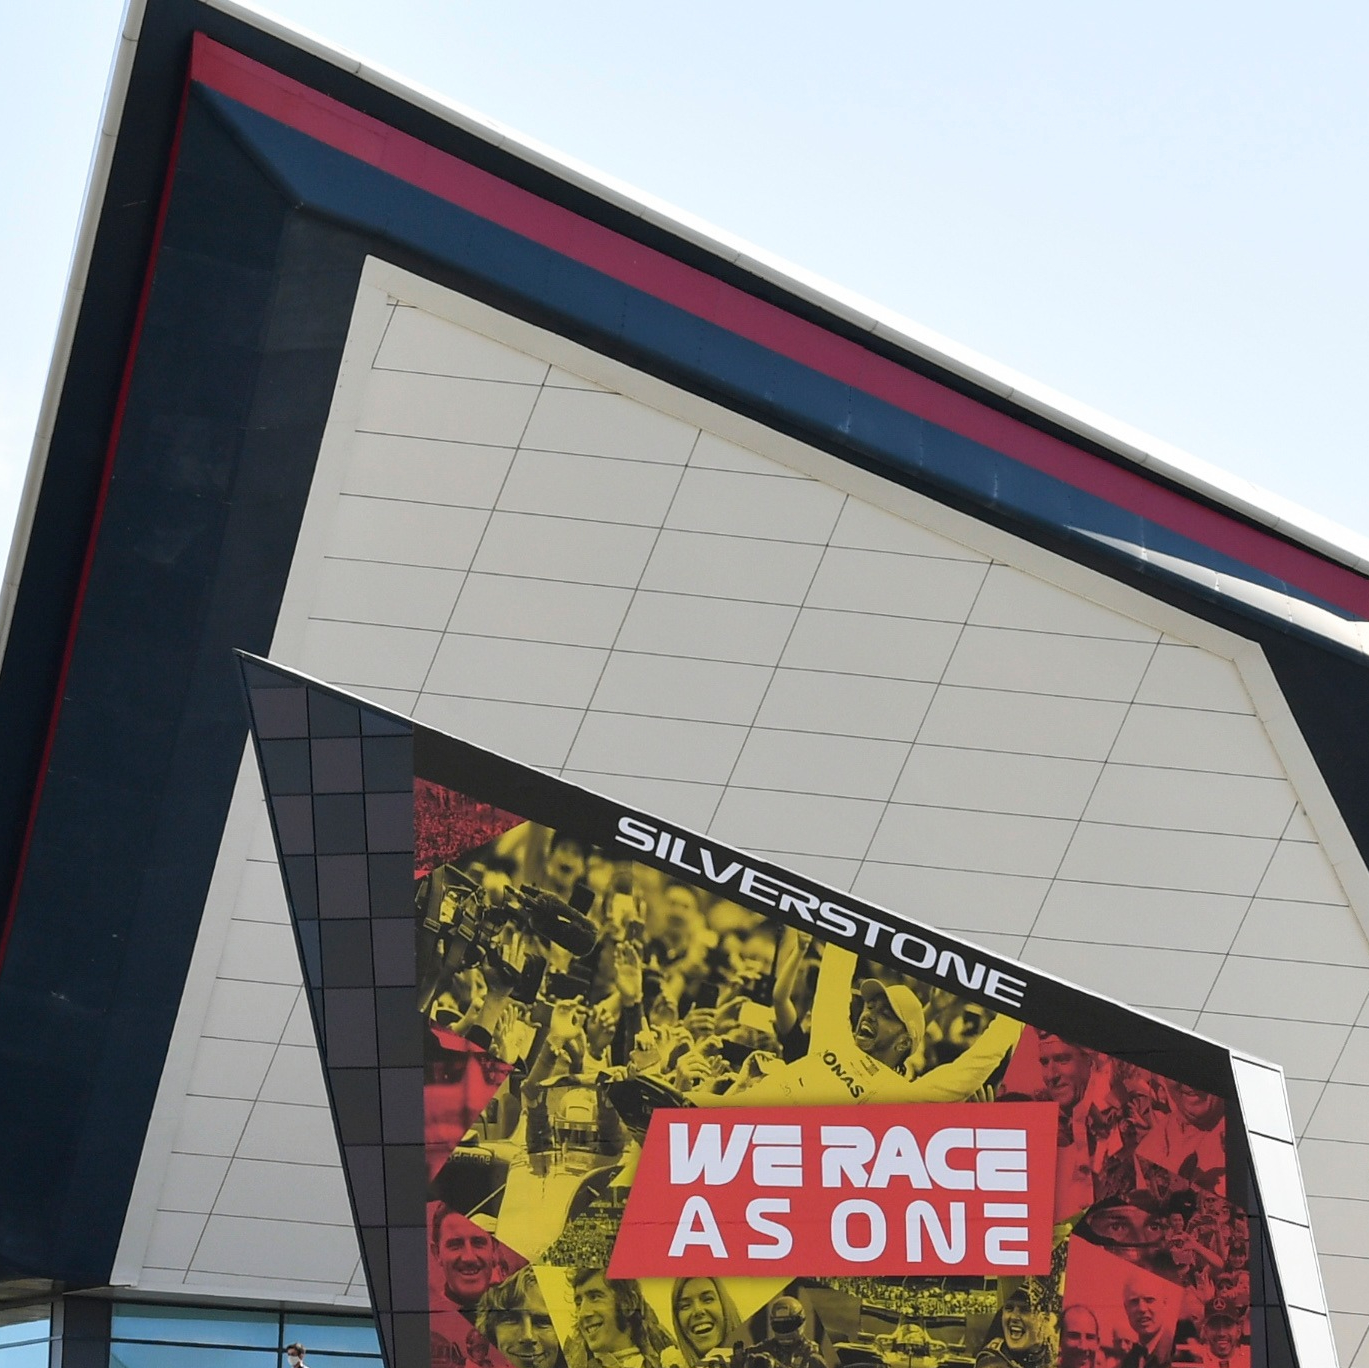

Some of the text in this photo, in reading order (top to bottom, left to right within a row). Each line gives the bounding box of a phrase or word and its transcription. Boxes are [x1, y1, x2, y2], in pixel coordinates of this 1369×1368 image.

[616, 816, 1028, 1009] SILVERSTONE
[669, 1122, 1028, 1192] WE RACE
[669, 1195, 1030, 1266] AS ONE
